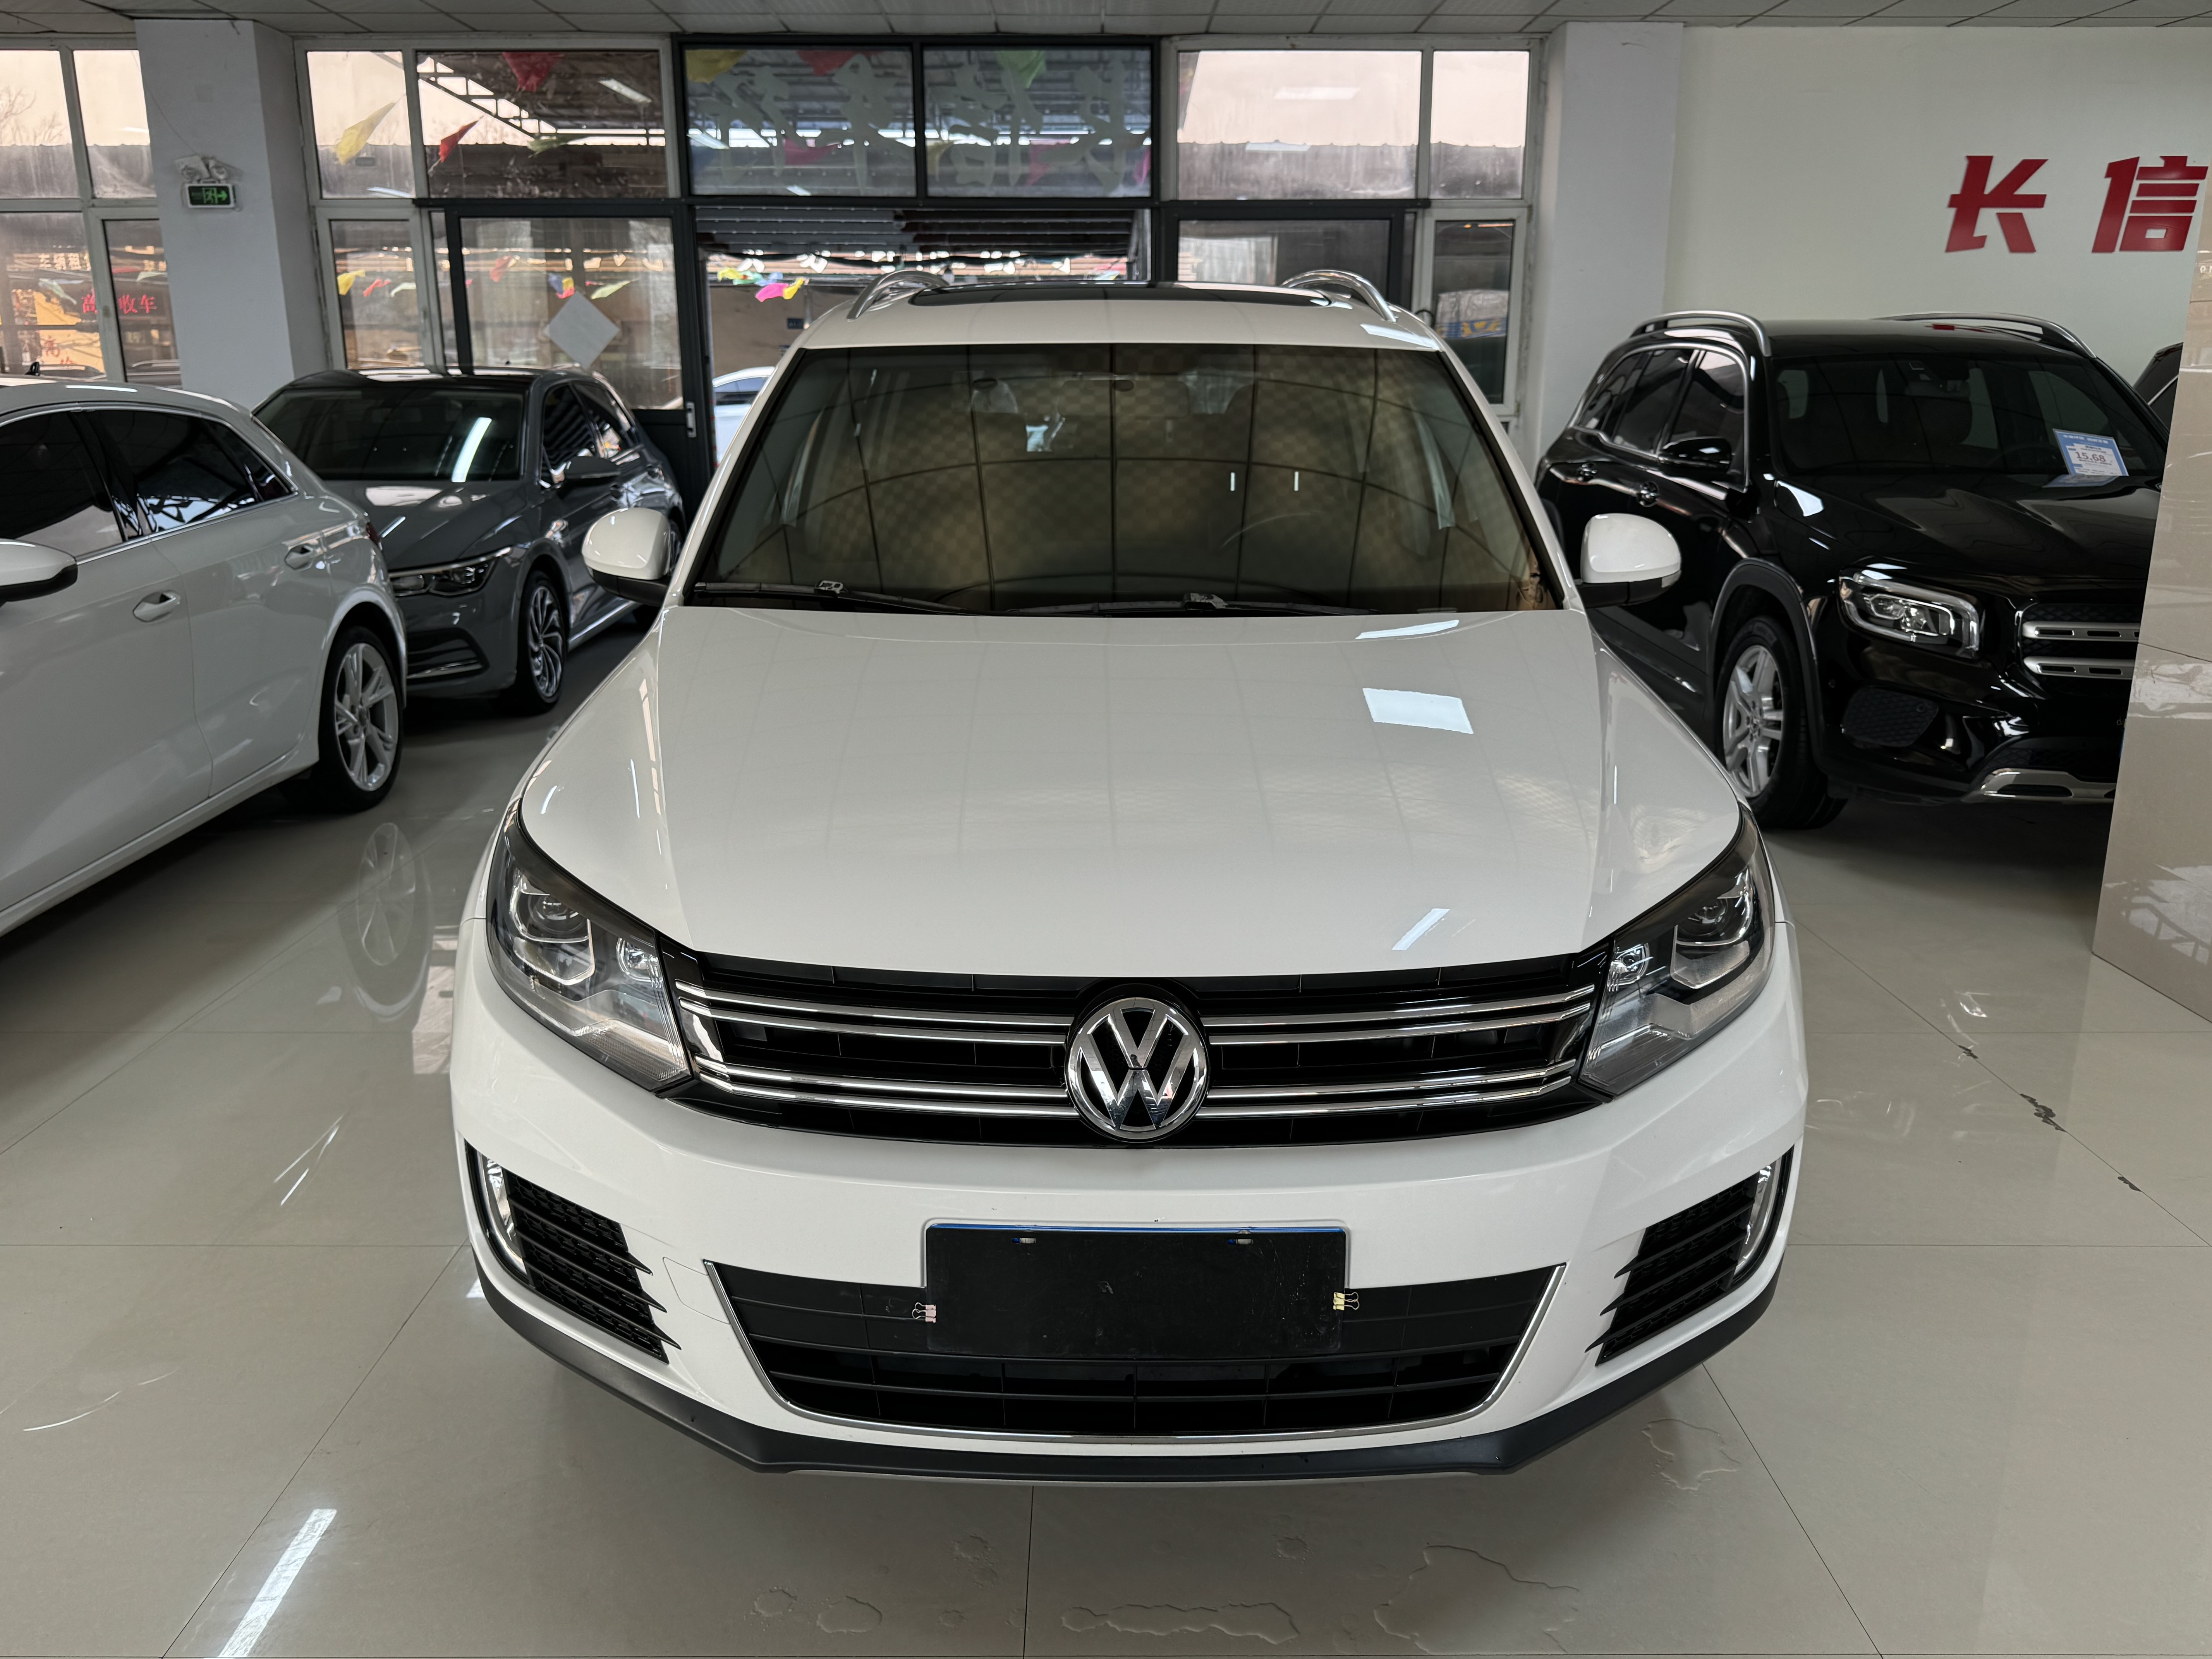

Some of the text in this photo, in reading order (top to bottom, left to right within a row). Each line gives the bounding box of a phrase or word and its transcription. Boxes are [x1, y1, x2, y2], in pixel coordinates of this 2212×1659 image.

[1946, 155, 2209, 253] 长信
[2075, 452, 2106, 462] 15.68
[1070, 999, 1205, 1136] VW
